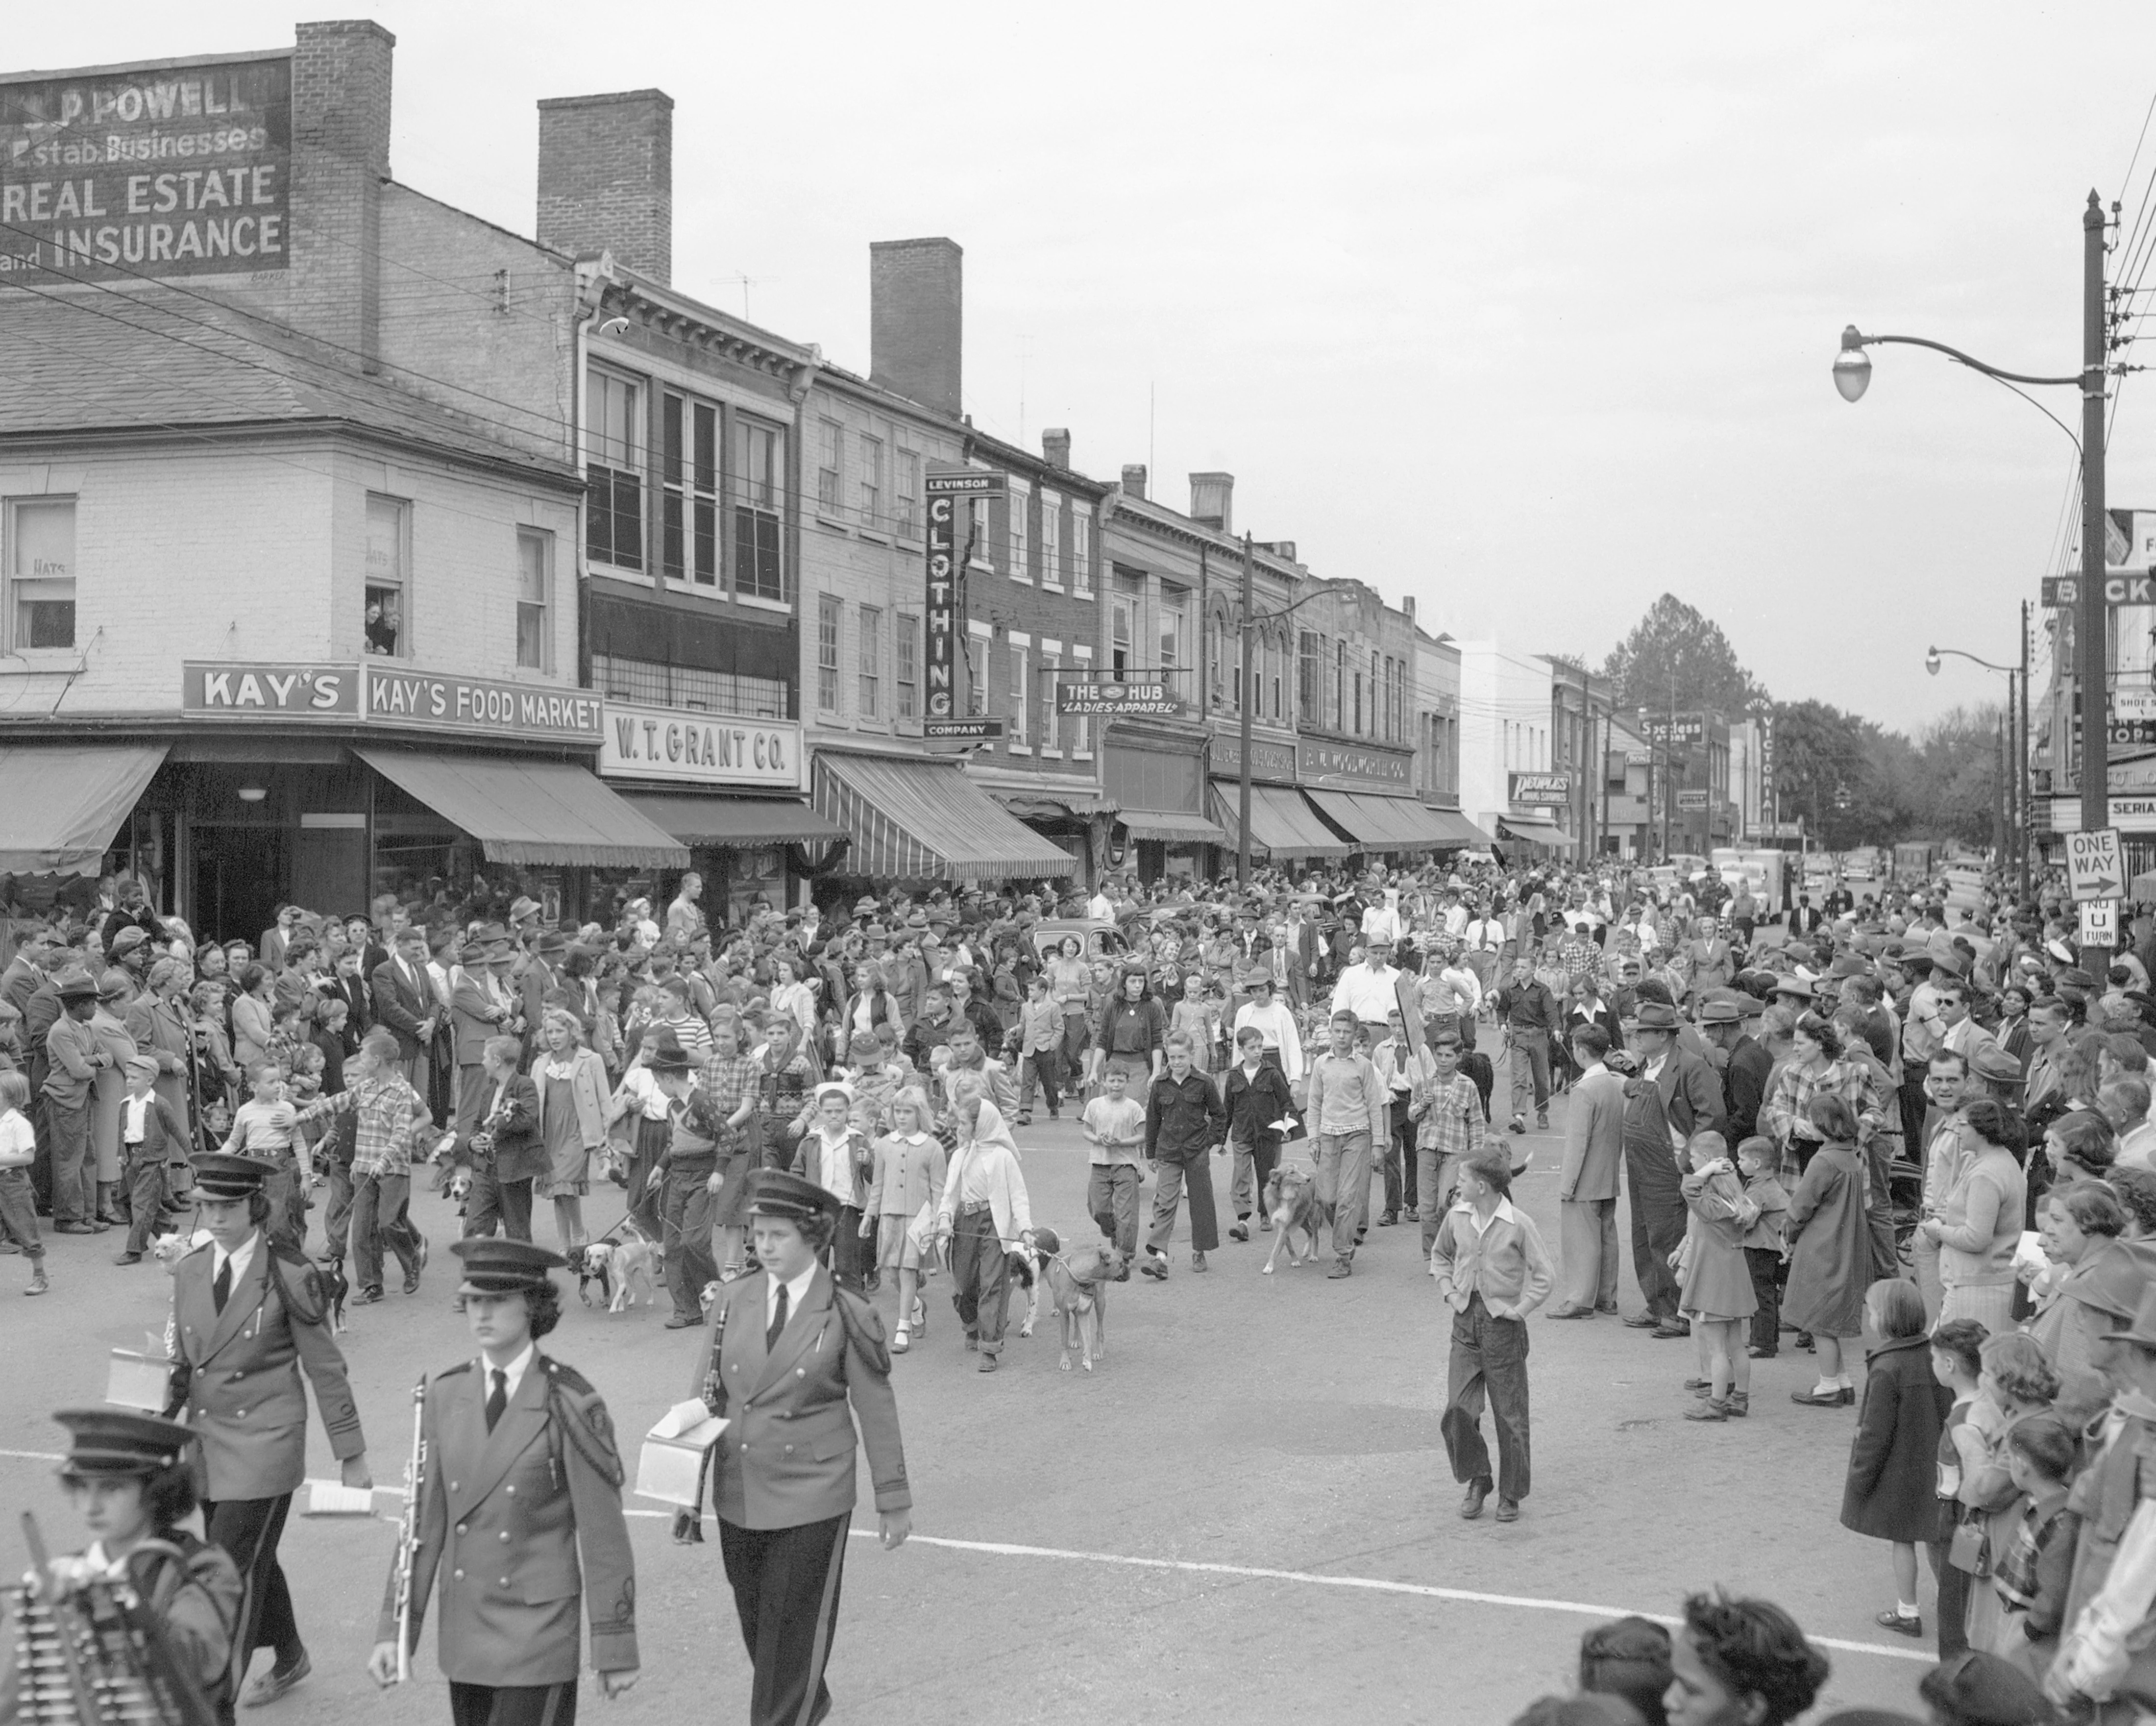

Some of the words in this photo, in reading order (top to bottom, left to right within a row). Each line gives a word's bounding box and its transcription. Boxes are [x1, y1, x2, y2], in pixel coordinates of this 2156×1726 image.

[93, 76, 246, 123] POWELL
[106, 128, 269, 161] Businesses
[3, 178, 107, 222] REAL
[127, 164, 275, 214] ESTATE
[0, 242, 41, 271] and
[54, 215, 282, 268] INSURANCE
[929, 479, 988, 489] LEVINSON
[2057, 579, 2151, 603] BCK
[931, 499, 951, 715] CLOTHING
[203, 671, 342, 710] KAY'S
[371, 677, 447, 717] KAY'S
[455, 686, 514, 723] FOOD
[520, 694, 601, 730] MARKET
[1067, 685, 1100, 700] THE
[1128, 685, 1163, 700] HUB
[2121, 698, 2146, 707] SHOE
[929, 725, 986, 736] COMPANY
[666, 723, 746, 768] GRANT
[754, 732, 786, 770] CO.
[1763, 716, 1774, 809] VICTORIA
[2074, 835, 2113, 854] ONE
[2075, 854, 2114, 874] WAY
[2091, 913, 2106, 927] U
[2086, 931, 2112, 941] TURN
